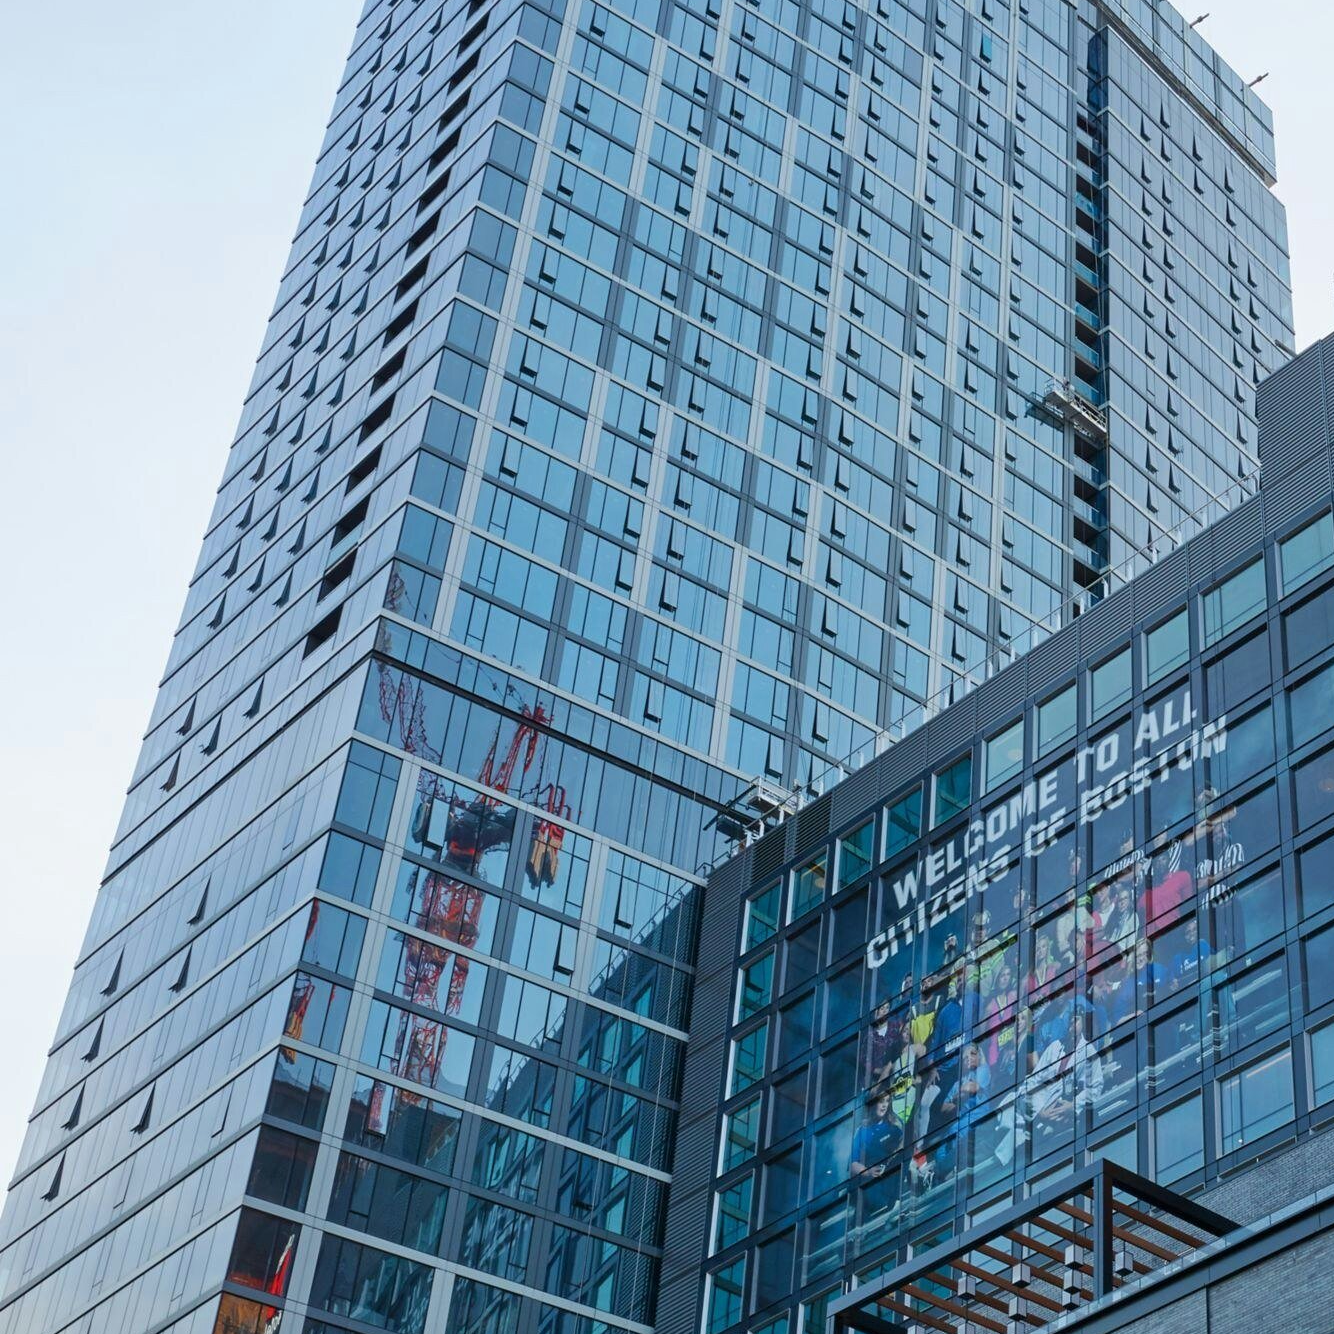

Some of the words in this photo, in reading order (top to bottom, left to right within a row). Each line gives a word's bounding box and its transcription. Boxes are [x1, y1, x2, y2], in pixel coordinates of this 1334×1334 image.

[867, 844, 1011, 969] CITIZENS
[1024, 808, 1066, 857] OF
[1080, 714, 1228, 825] BOSTON
[893, 770, 1058, 909] WELCOME
[1074, 734, 1119, 784] TO
[1134, 691, 1198, 750] ALL
